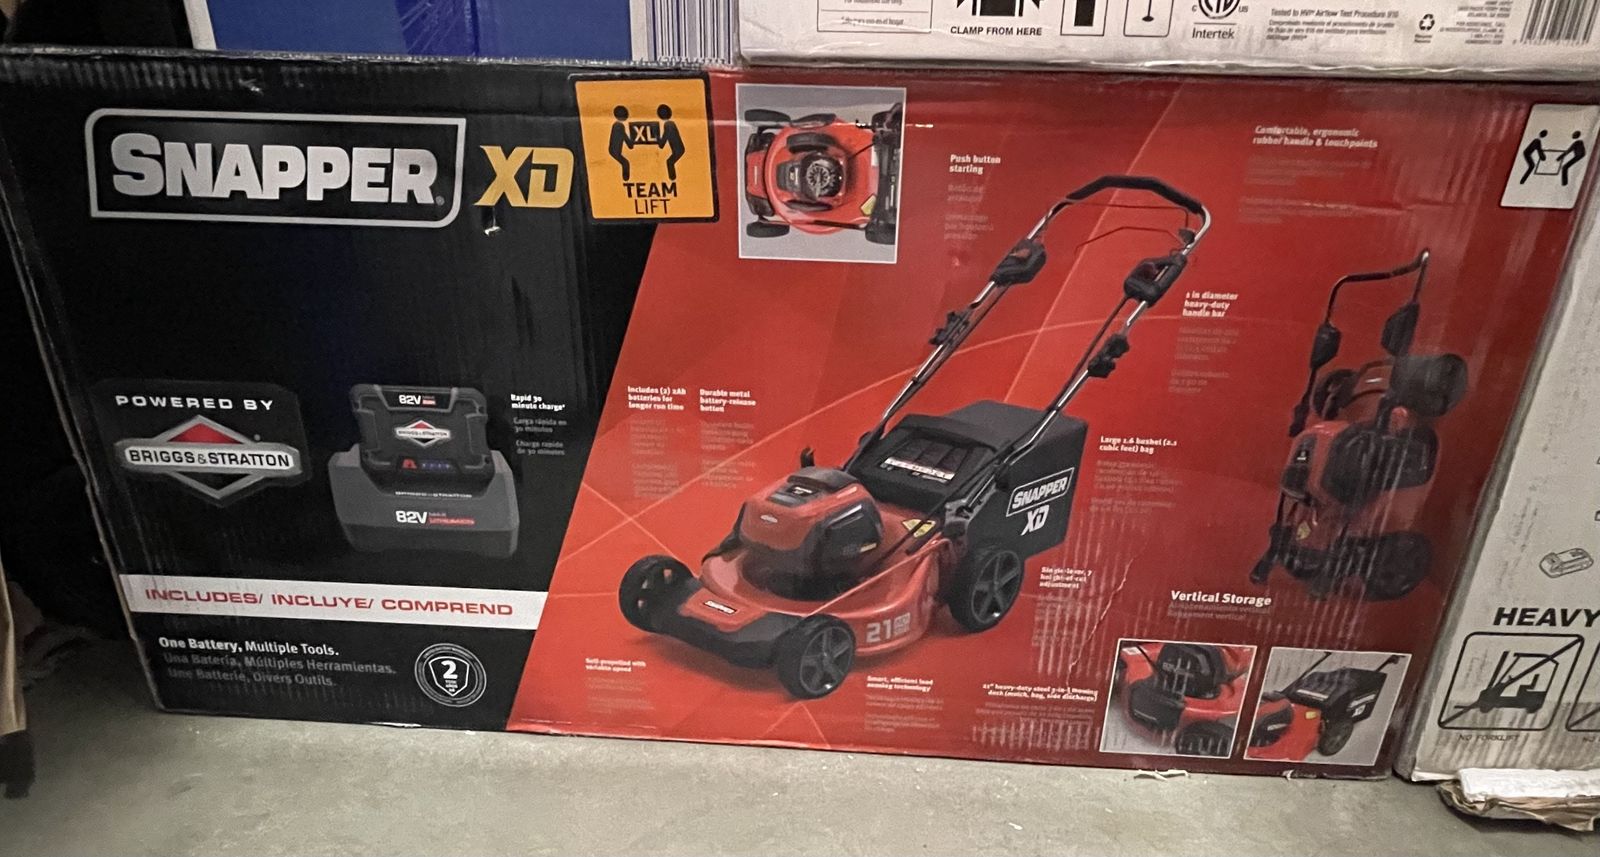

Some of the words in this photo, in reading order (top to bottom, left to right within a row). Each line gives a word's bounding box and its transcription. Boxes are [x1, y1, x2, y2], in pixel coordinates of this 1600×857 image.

[950, 26, 984, 36] CLAMP
[986, 26, 1014, 36] FROM
[1016, 26, 1042, 37] HERE
[1192, 27, 1235, 39] Intertek
[634, 125, 657, 142] XL
[1254, 125, 1310, 136] Comfortable,
[1313, 128, 1360, 138] ergonomic
[1252, 136, 1282, 145] rubber
[1283, 136, 1314, 146] handle
[1315, 138, 1323, 147] &
[1324, 138, 1378, 149] touchpoints
[950, 154, 971, 163] Push
[973, 155, 1001, 164] button
[110, 132, 438, 205] SNAPPER
[474, 145, 575, 209] XD
[949, 164, 984, 175] starting
[623, 182, 678, 198] TEAM
[634, 199, 670, 214] LIFT
[1192, 290, 1200, 298] in
[1201, 291, 1239, 300] diameter
[1184, 299, 1230, 311] heavy-duty
[1182, 308, 1210, 317] handle
[1211, 309, 1226, 317] bar
[627, 385, 659, 394] Includes
[700, 388, 728, 397] Durable
[729, 390, 751, 398] metal
[115, 394, 233, 410] POWERED
[243, 399, 273, 411] BY
[398, 394, 422, 405] 82V
[510, 393, 531, 403] Rapid
[628, 394, 661, 402] batteries
[700, 396, 757, 406] battery-release
[628, 401, 652, 411] longer
[667, 403, 685, 411] time
[700, 404, 725, 413] button
[1100, 435, 1122, 446] Large
[1136, 437, 1162, 446] bushel
[1099, 443, 1119, 451] cubic
[1120, 445, 1139, 453] feet)
[1140, 445, 1155, 455] bag
[1012, 476, 1068, 509] SNAPPER
[395, 510, 428, 524] 82V
[1021, 504, 1050, 536] XD
[1039, 581, 1080, 589] adjustment
[145, 588, 263, 604] INCLUDES/
[271, 593, 374, 609] INCLUYE/
[381, 598, 513, 615] COMPREND
[1170, 589, 1219, 603] Vertical
[1221, 592, 1272, 608] Storage
[1493, 607, 1600, 628] HEAVY
[866, 619, 892, 643] 21
[158, 636, 186, 649] One
[188, 638, 243, 653] Battery,
[244, 641, 298, 656] Multiple
[300, 643, 339, 656] Tools.
[163, 653, 188, 664] Una
[191, 654, 241, 668] Batería,
[244, 656, 304, 671] Múltiples
[306, 659, 397, 674] Herramientas.
[441, 660, 458, 680] 2
[167, 667, 193, 679] Une
[196, 669, 250, 683] Batterie,
[294, 673, 337, 687] Outils.
